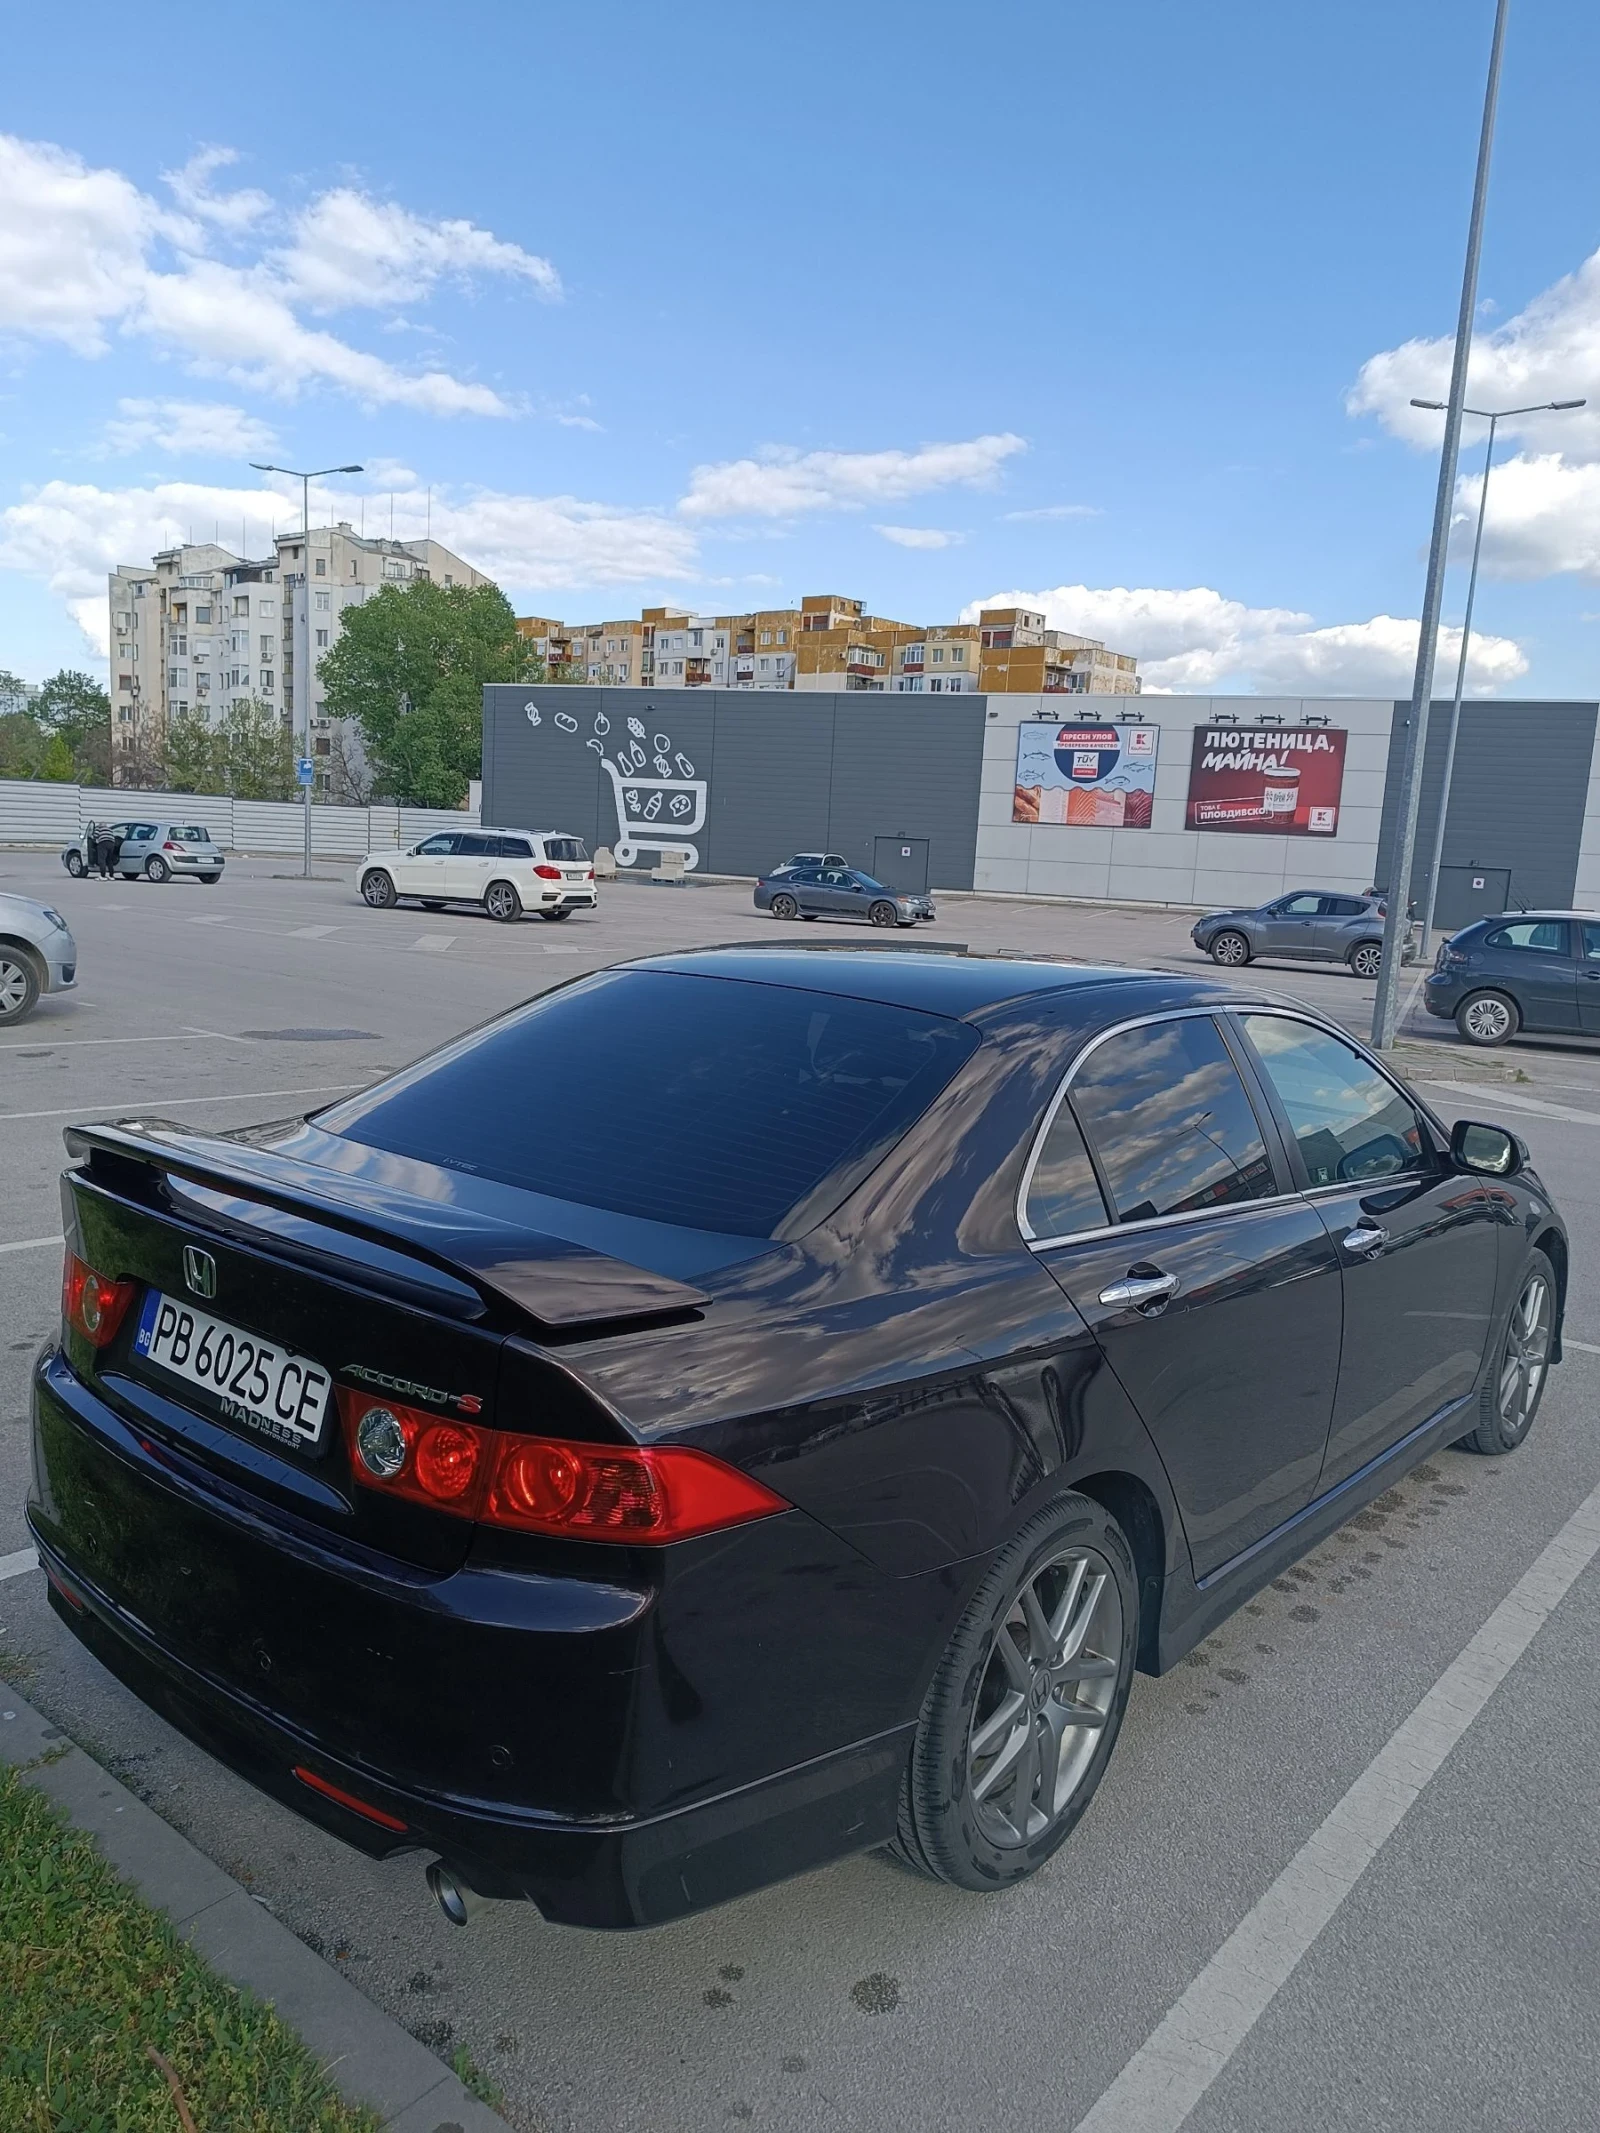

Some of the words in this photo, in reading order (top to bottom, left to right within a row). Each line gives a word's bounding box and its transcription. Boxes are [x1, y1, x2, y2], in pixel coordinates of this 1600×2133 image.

[1062, 733, 1090, 741] ПРЕСЕН
[1092, 733, 1113, 741] УЛОВ
[1204, 731, 1335, 754] ЛЮТЕНИЦА,
[1201, 748, 1290, 772] МАЙНА!
[138, 1328, 151, 1347] BG
[195, 1324, 275, 1405] 6025
[220, 1397, 302, 1444] MADNESS
[259, 1426, 301, 1450] MOTORSPORT
